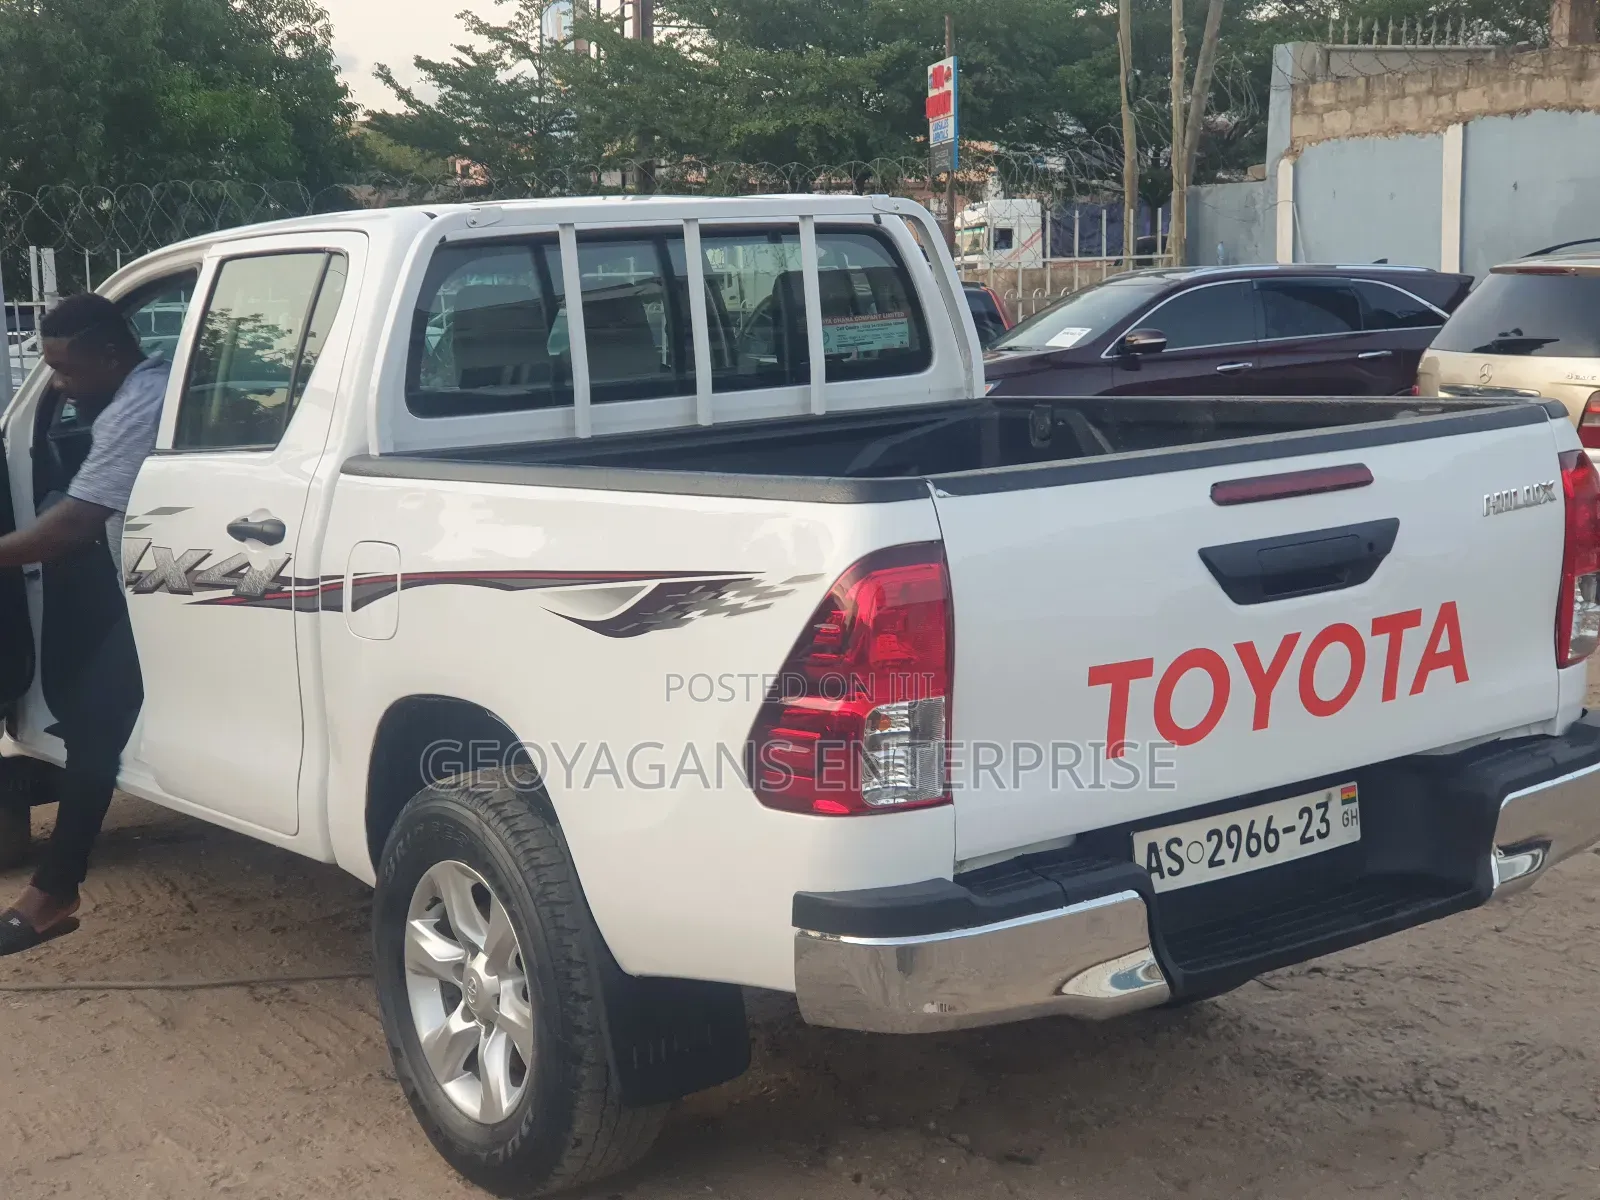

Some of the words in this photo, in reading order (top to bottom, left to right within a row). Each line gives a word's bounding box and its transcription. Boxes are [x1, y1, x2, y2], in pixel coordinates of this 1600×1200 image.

[1483, 480, 1557, 517] HILUX
[1087, 601, 1470, 760] TOYOTA
[1206, 801, 1331, 869] 2966-23
[1341, 807, 1359, 829] GH
